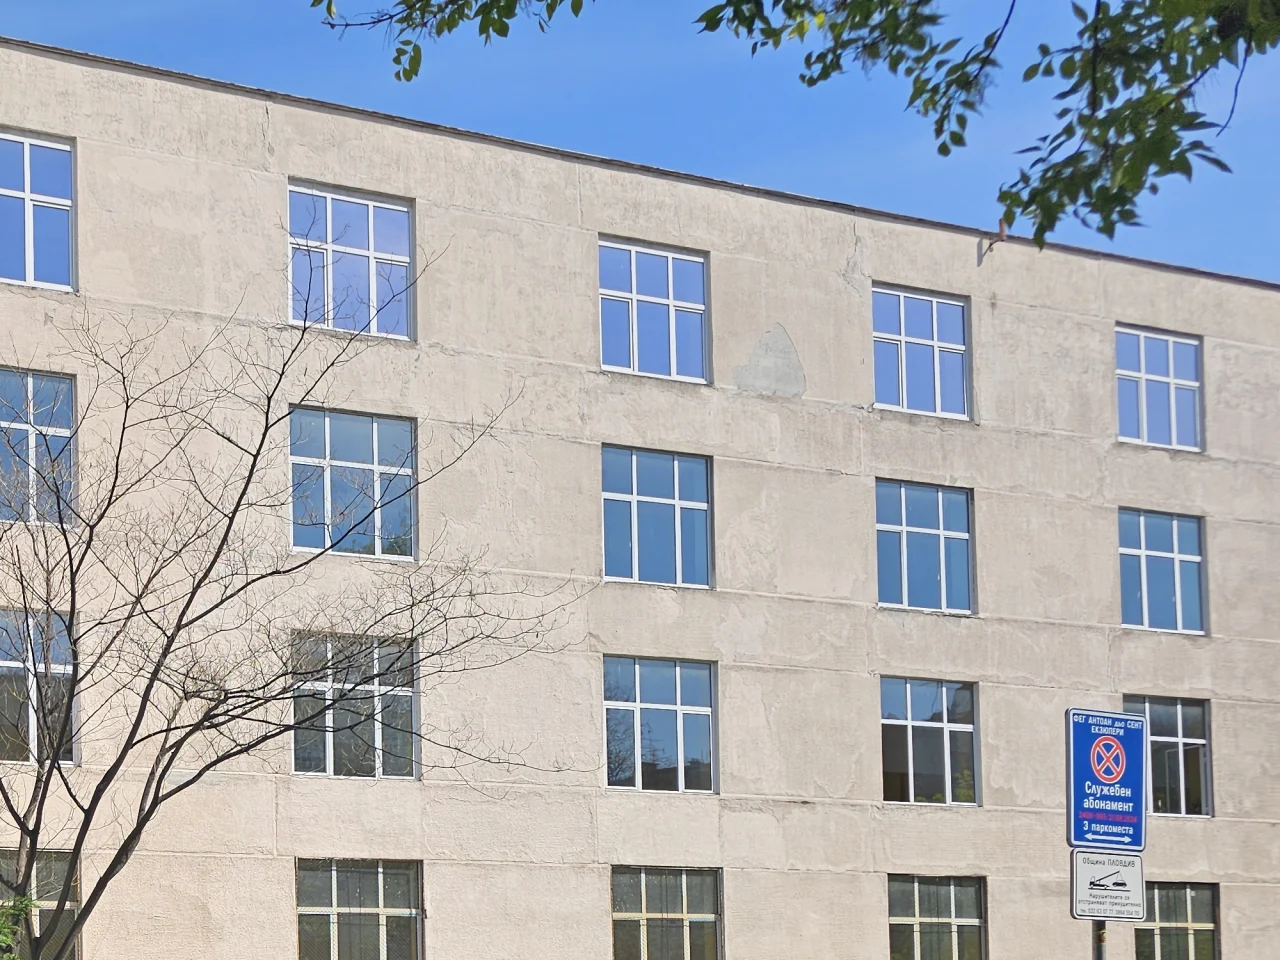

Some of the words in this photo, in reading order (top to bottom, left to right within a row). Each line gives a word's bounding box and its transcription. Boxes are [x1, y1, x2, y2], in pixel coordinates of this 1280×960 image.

[1088, 717, 1112, 726] АНТОАН
[1126, 720, 1143, 729] СЕНТ
[1091, 725, 1125, 736] ЕКЗЮПЕРИ
[1085, 780, 1132, 798] Служебен
[1083, 796, 1134, 812] абонамент
[1083, 820, 1089, 831] 3
[1091, 823, 1134, 835] паркоместа
[1082, 857, 1106, 866] Община
[1107, 858, 1136, 868] ПЛОВДИВ
